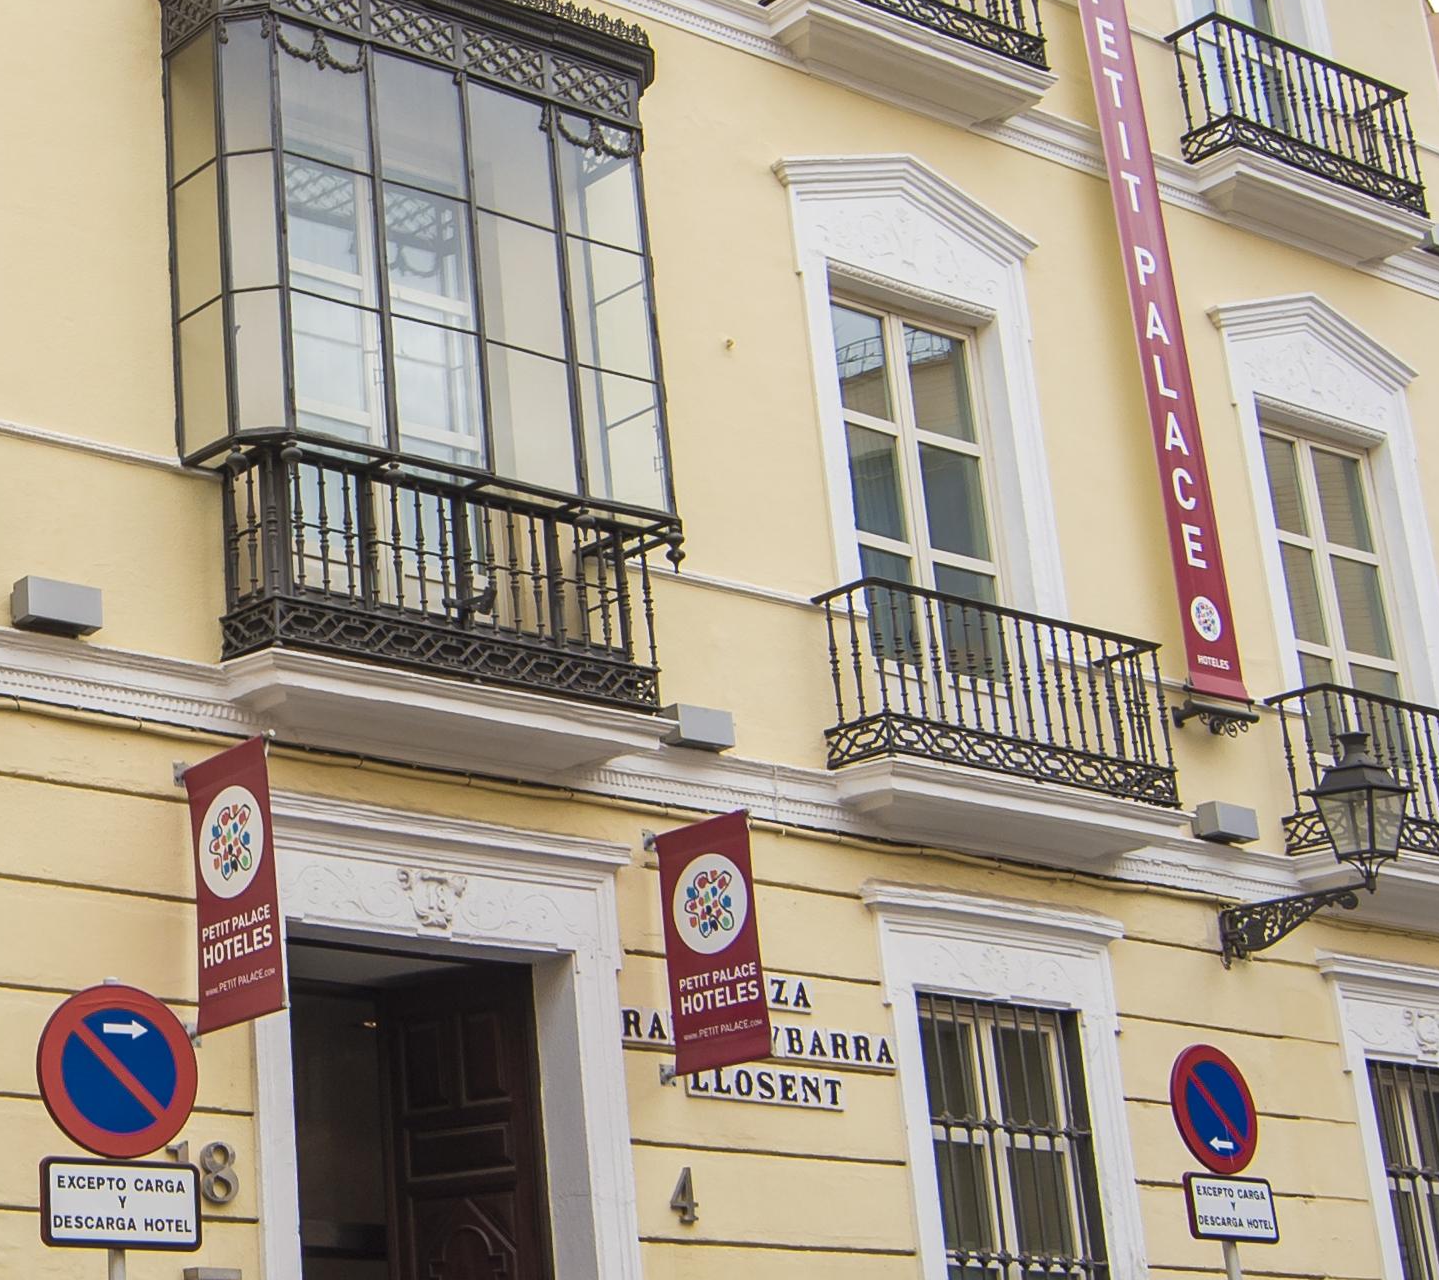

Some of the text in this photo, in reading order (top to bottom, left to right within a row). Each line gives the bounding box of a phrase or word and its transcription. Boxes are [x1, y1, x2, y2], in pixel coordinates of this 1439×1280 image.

[1135, 245, 1207, 570] PALACE
[1197, 654, 1230, 671] HOTELES
[202, 903, 271, 943] PETIT PALACE
[202, 923, 273, 969] HOTELES
[679, 961, 757, 993] PETIT PALACE
[680, 980, 760, 1016] HOTELES
[770, 978, 812, 1009] ZA
[621, 1008, 674, 1041] RA
[690, 1068, 842, 1107] LLOSENT
[57, 1175, 186, 1194] EXCEPTO CARGA
[670, 1166, 699, 1224] 4
[1196, 1185, 1266, 1200] EXCEPTO CARGA
[118, 1195, 127, 1209] Y
[1230, 1201, 1236, 1211] Y
[53, 1214, 192, 1233] DESCARGA HOTEL
[1198, 1214, 1273, 1230] DESCARGA HOTEL
